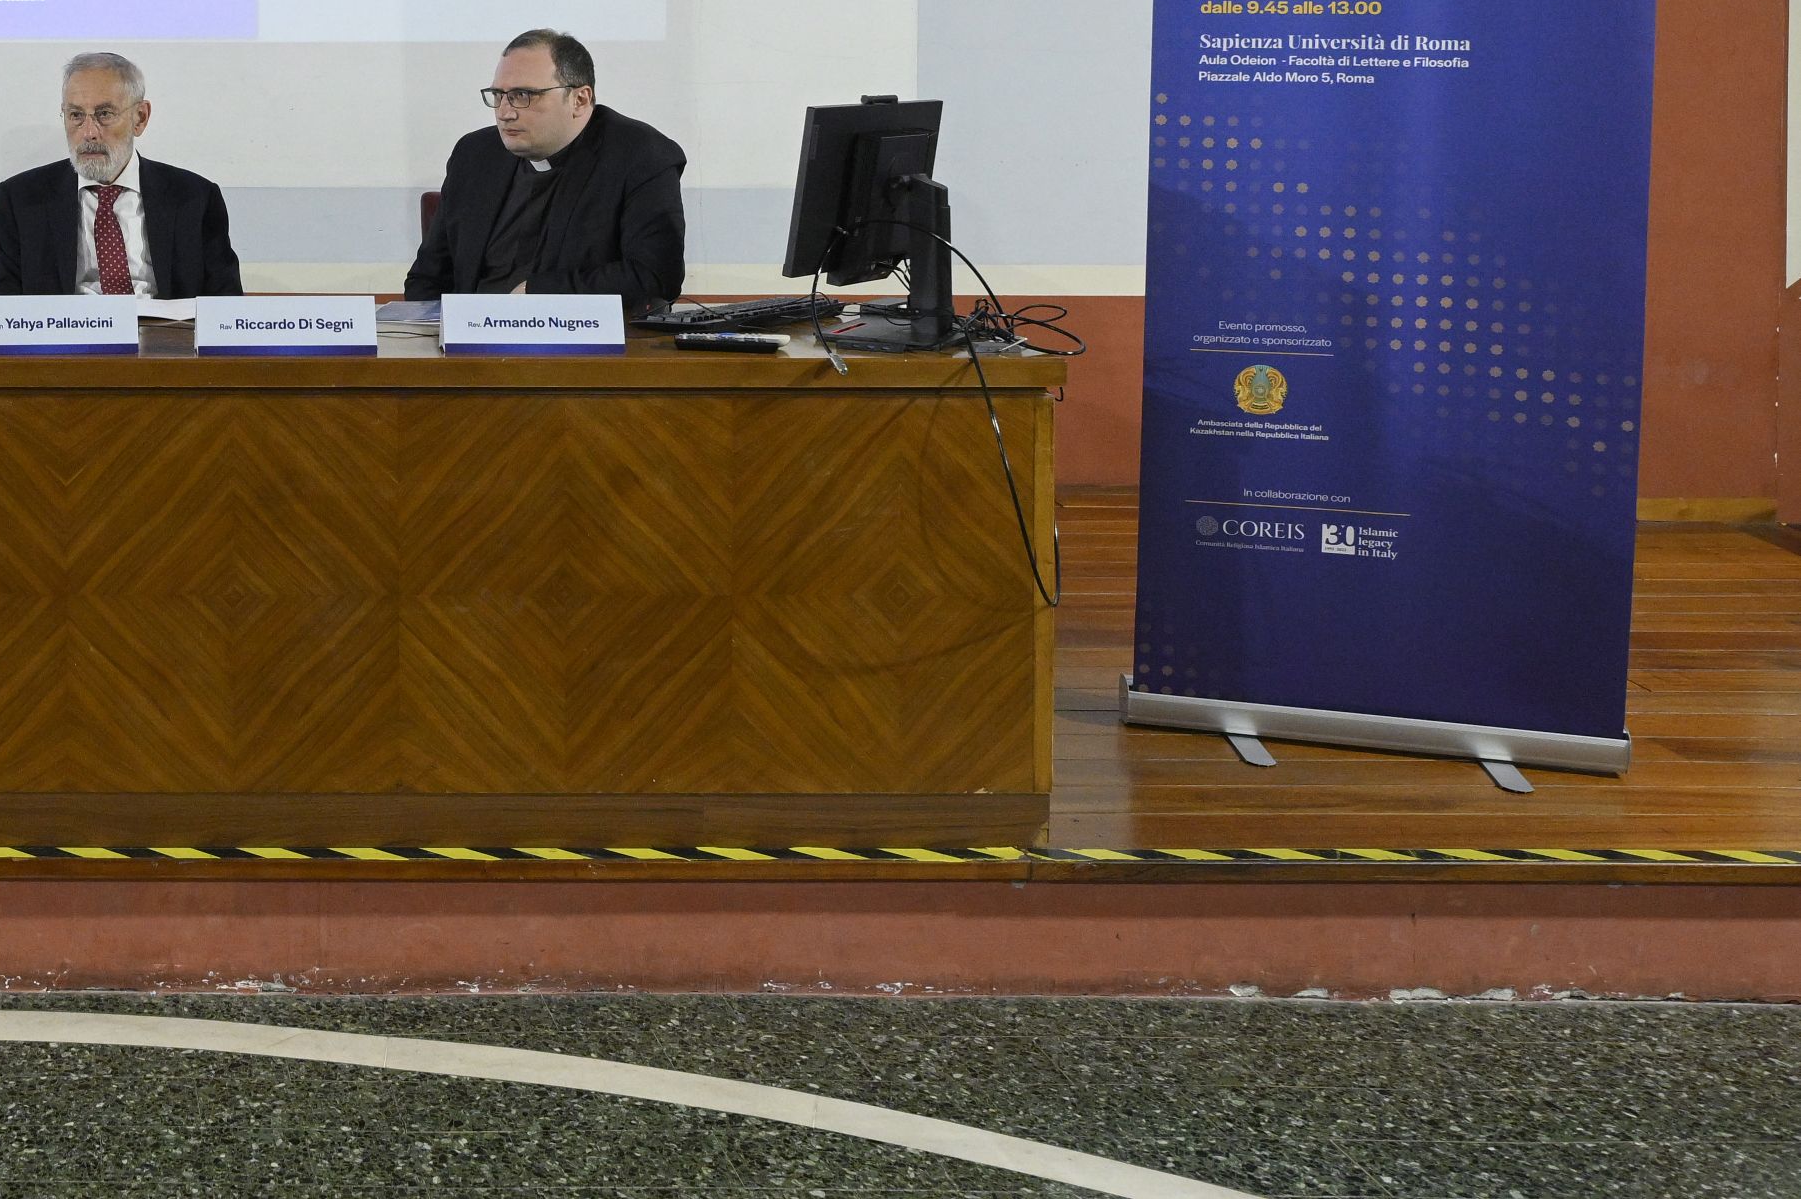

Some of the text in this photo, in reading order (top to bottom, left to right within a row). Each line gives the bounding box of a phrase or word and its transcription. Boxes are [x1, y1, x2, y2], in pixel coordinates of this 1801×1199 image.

[1201, 1, 1382, 15] dalle 9.45 alle 13.00
[1200, 34, 1470, 51] Sapienza Università di Roma
[1199, 55, 1227, 65] Aula
[1231, 55, 1276, 65] Odeion
[1289, 56, 1335, 66] Facoltà
[1338, 56, 1350, 66] di
[1353, 56, 1400, 67] Lettere
[1414, 57, 1469, 68] Filosofia
[1199, 72, 1374, 84] Piazzale Aldo Moro 5, Roma
[5, 318, 43, 331] Yahya
[47, 317, 113, 328] Pallavicini
[236, 319, 295, 330] Riccardo
[299, 319, 312, 329] Di
[316, 318, 353, 333] Segni
[483, 317, 545, 328] Armando
[549, 317, 599, 331] Nugnes
[1219, 321, 1307, 334] Evento promosso,
[1193, 335, 1251, 344] organizzato
[1262, 338, 1332, 347] sponsorizzato
[1265, 422, 1308, 431] Repubblica
[1190, 428, 1234, 436] Kazakhstan
[1256, 431, 1299, 439] Repubblica
[1244, 488, 1252, 496] In
[1255, 490, 1329, 502] collaborazione
[1223, 520, 1305, 540] COREIS
[1359, 527, 1398, 537] Islamic
[1359, 537, 1393, 549] legacy
[1358, 548, 1369, 556] in
[1373, 549, 1398, 560] Italy
